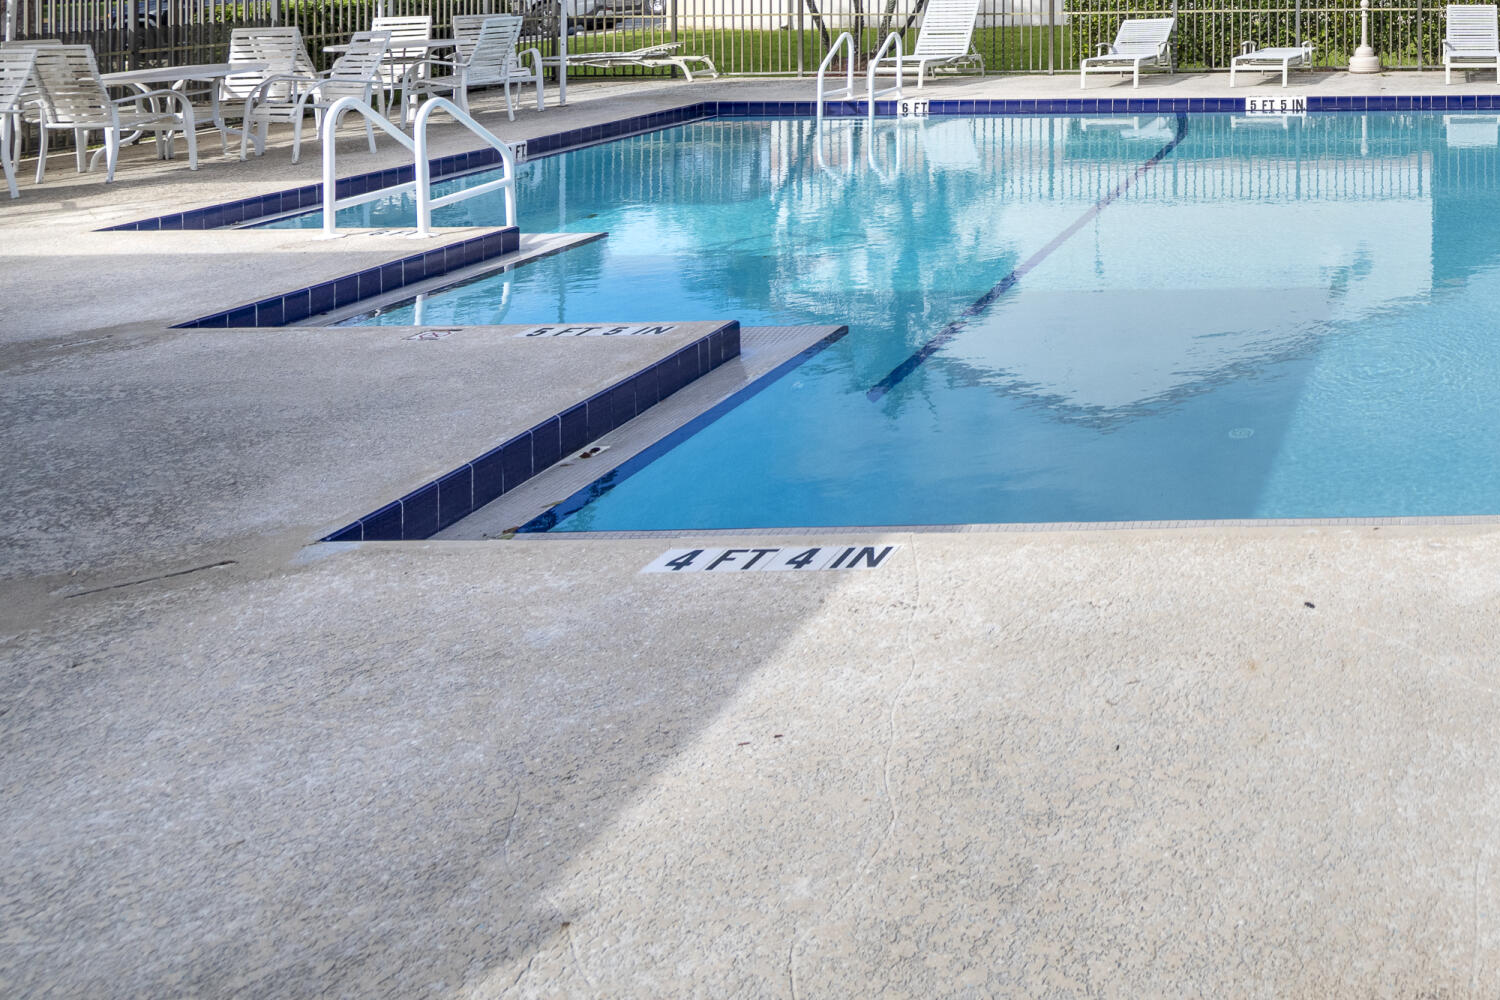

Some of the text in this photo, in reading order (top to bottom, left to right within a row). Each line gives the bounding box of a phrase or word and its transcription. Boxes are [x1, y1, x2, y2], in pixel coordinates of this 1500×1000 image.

[902, 102, 908, 114] 6
[1250, 100, 1257, 111] 5
[1280, 100, 1287, 111] 5
[526, 326, 674, 336] 5 FT 5 IN
[665, 546, 894, 570] 4 FT 4 IN
